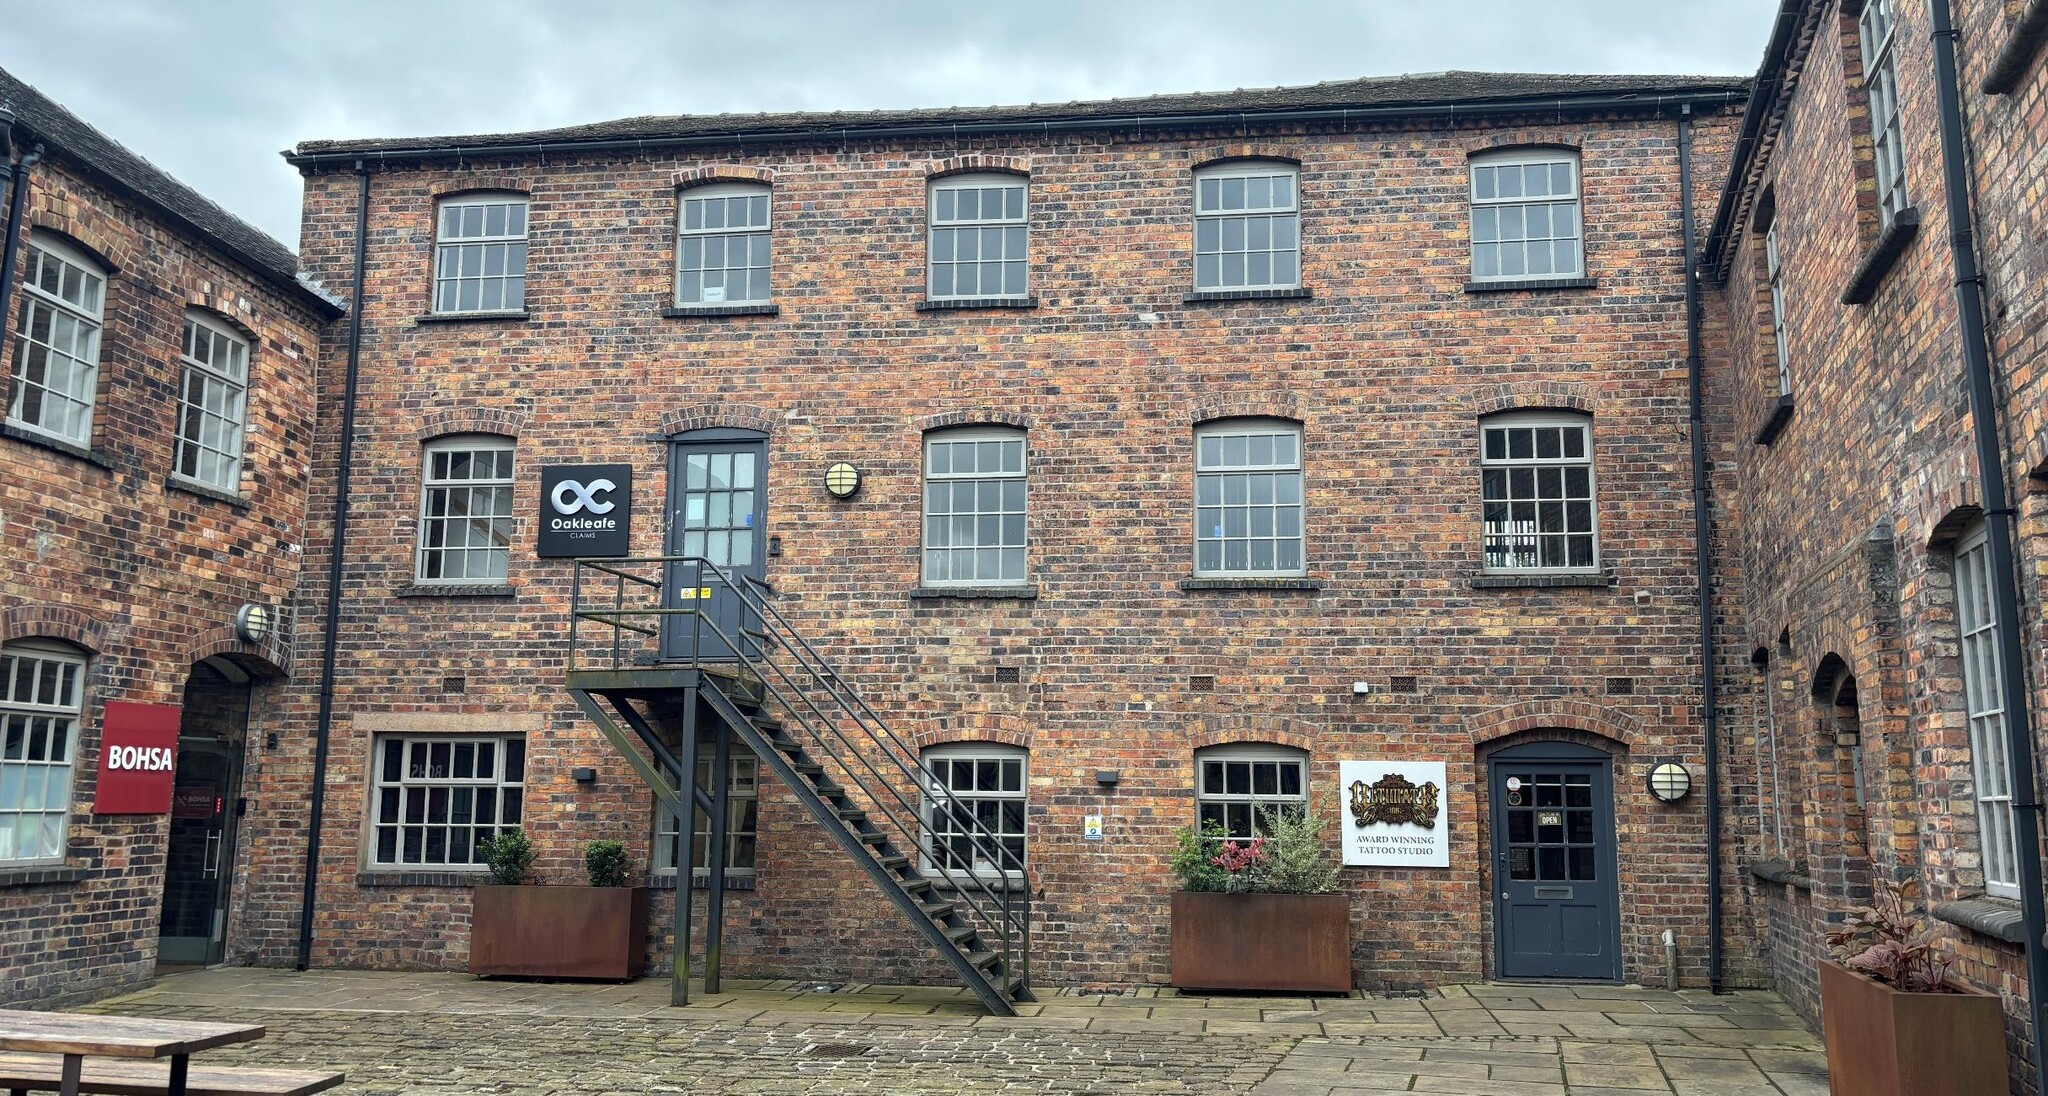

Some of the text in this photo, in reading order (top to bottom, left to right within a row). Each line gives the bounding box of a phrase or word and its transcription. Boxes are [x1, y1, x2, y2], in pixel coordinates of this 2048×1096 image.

[551, 517, 616, 529] Oakleafe
[108, 745, 173, 771] BOHSA
[1541, 816, 1558, 824] OPEN
[1391, 836, 1434, 845] WINNING
[1358, 846, 1434, 855] TATTOO STUDIO
